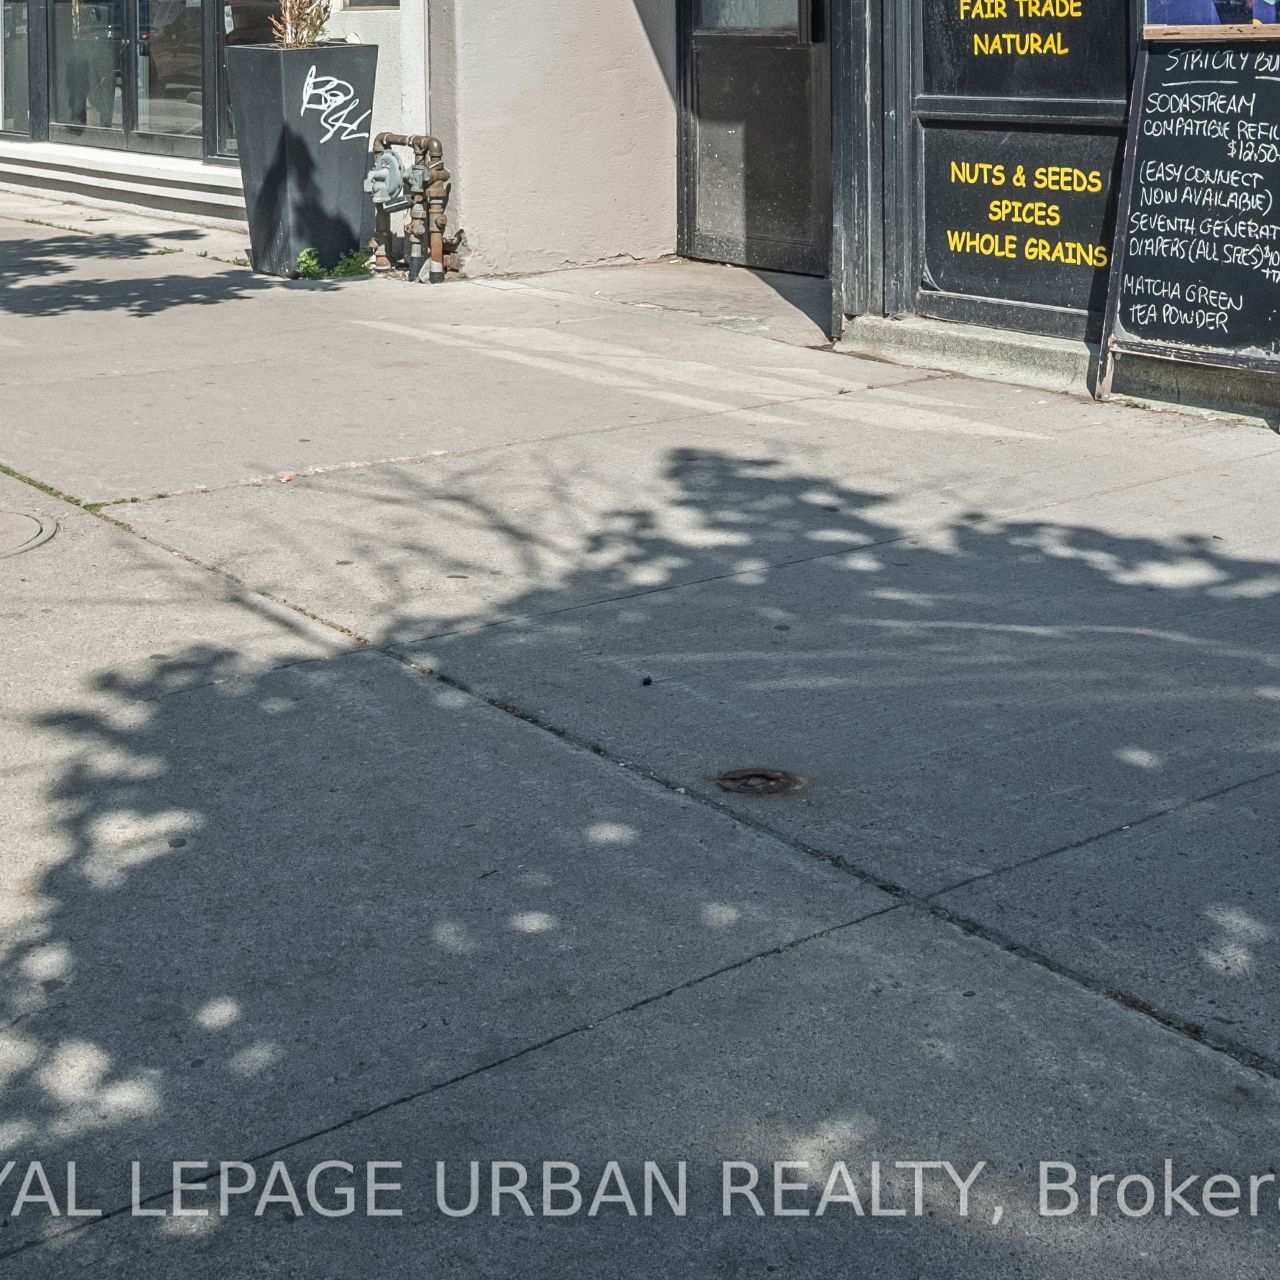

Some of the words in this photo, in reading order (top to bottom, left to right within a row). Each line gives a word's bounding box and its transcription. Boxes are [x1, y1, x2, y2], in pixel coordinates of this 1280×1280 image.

[973, 32, 1069, 56] NATURAL
[1165, 48, 1249, 72] STRICTLY
[1145, 91, 1257, 117] SODASTREAM
[1143, 117, 1231, 140] COMPATIBLE
[950, 161, 1006, 186] NUTS
[1013, 165, 1026, 188] &
[1033, 167, 1103, 192] SEEDS
[1184, 165, 1264, 188] CONNECT
[1140, 187, 1177, 207] NOW
[988, 200, 1061, 226] SPICES
[1129, 211, 1196, 235] SEVENTH
[946, 230, 1017, 258] WHOLE
[1024, 238, 1108, 267] GRAINS
[1124, 274, 1181, 300] MATCHA
[1185, 284, 1243, 310] GREEN
[1129, 303, 1157, 325] TEA
[1162, 303, 1229, 334] POWDER
